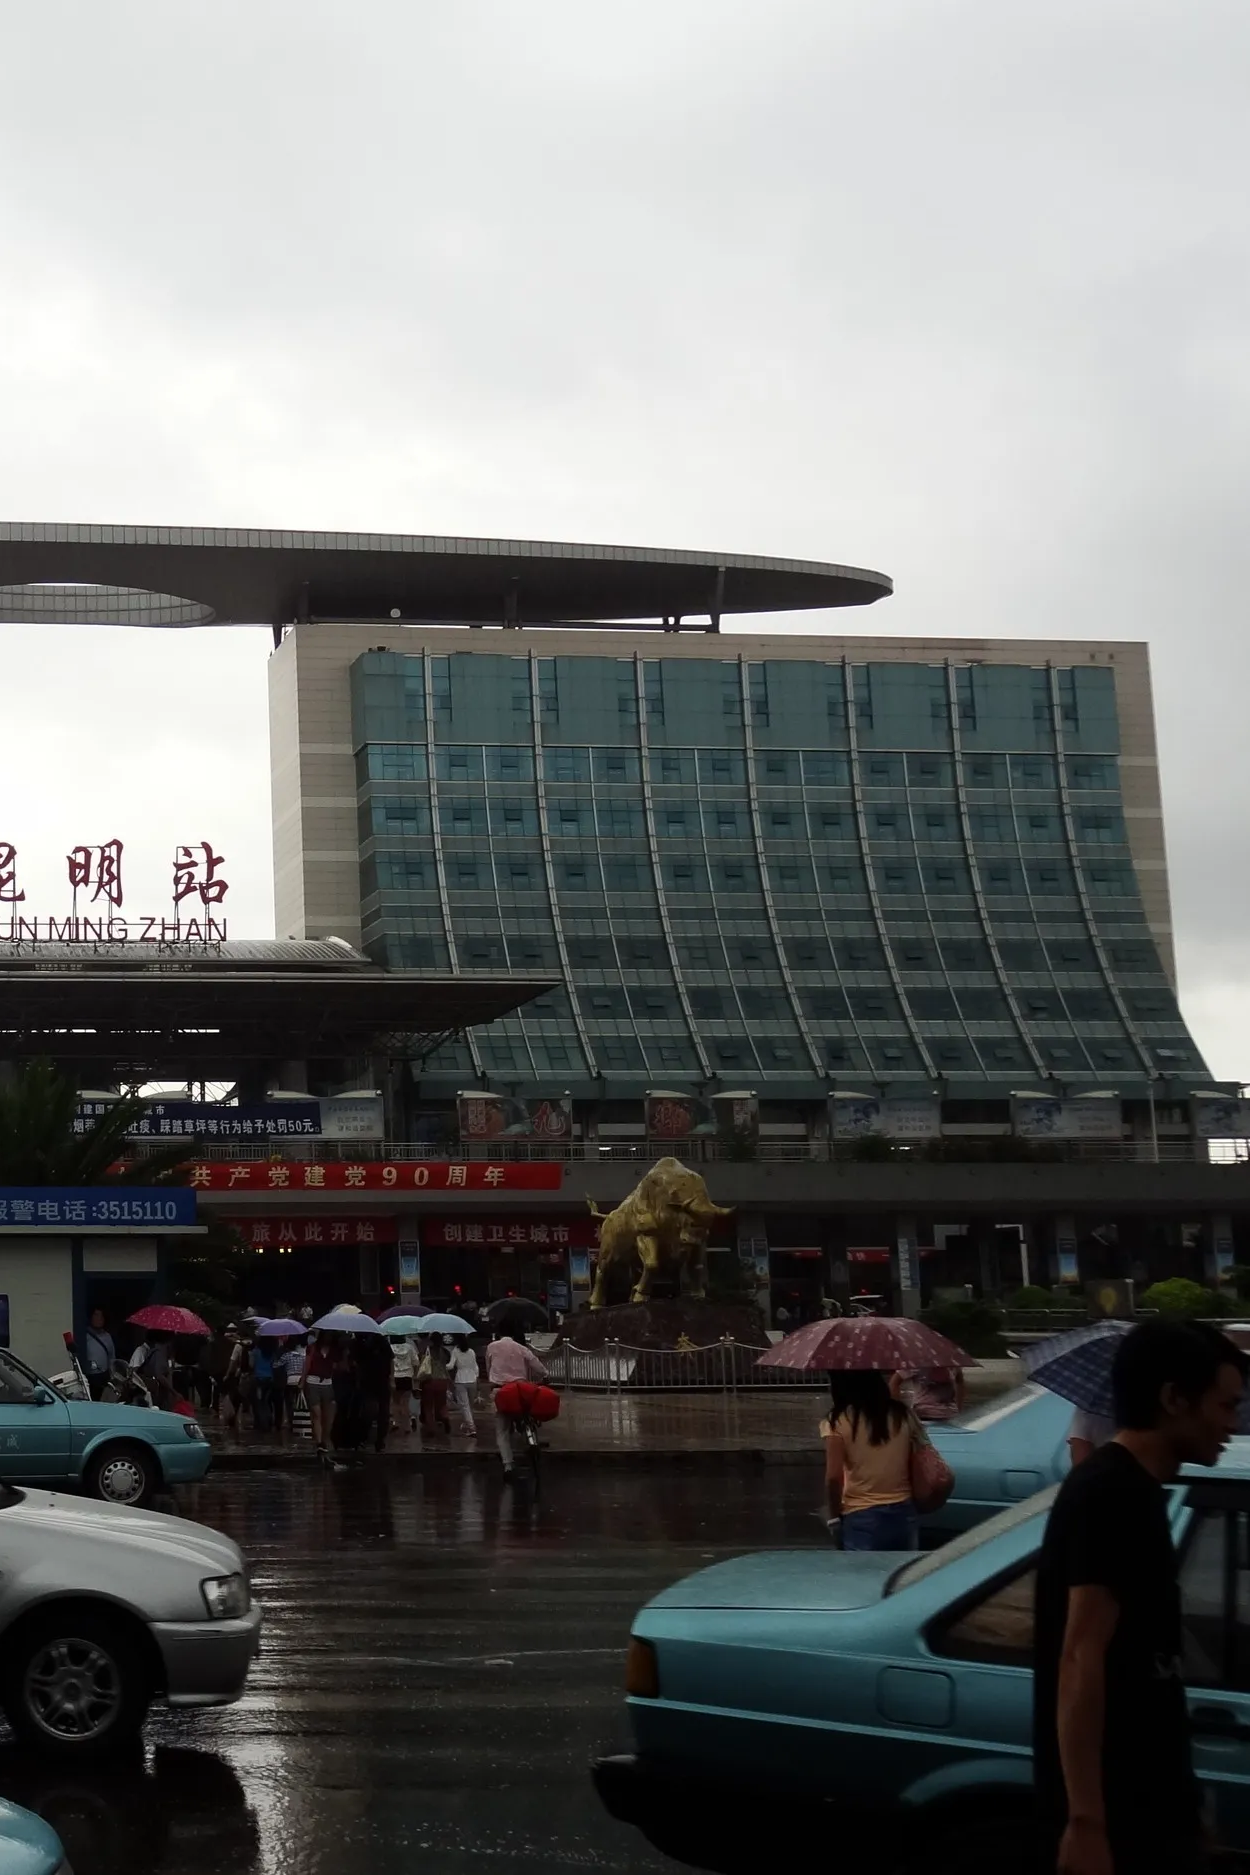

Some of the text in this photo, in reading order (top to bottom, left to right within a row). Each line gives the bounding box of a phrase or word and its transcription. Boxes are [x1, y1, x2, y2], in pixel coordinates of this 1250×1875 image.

[49, 916, 129, 942] MING
[139, 917, 227, 942] ZHAN
[442, 1222, 571, 1243] 创建卫生城市
